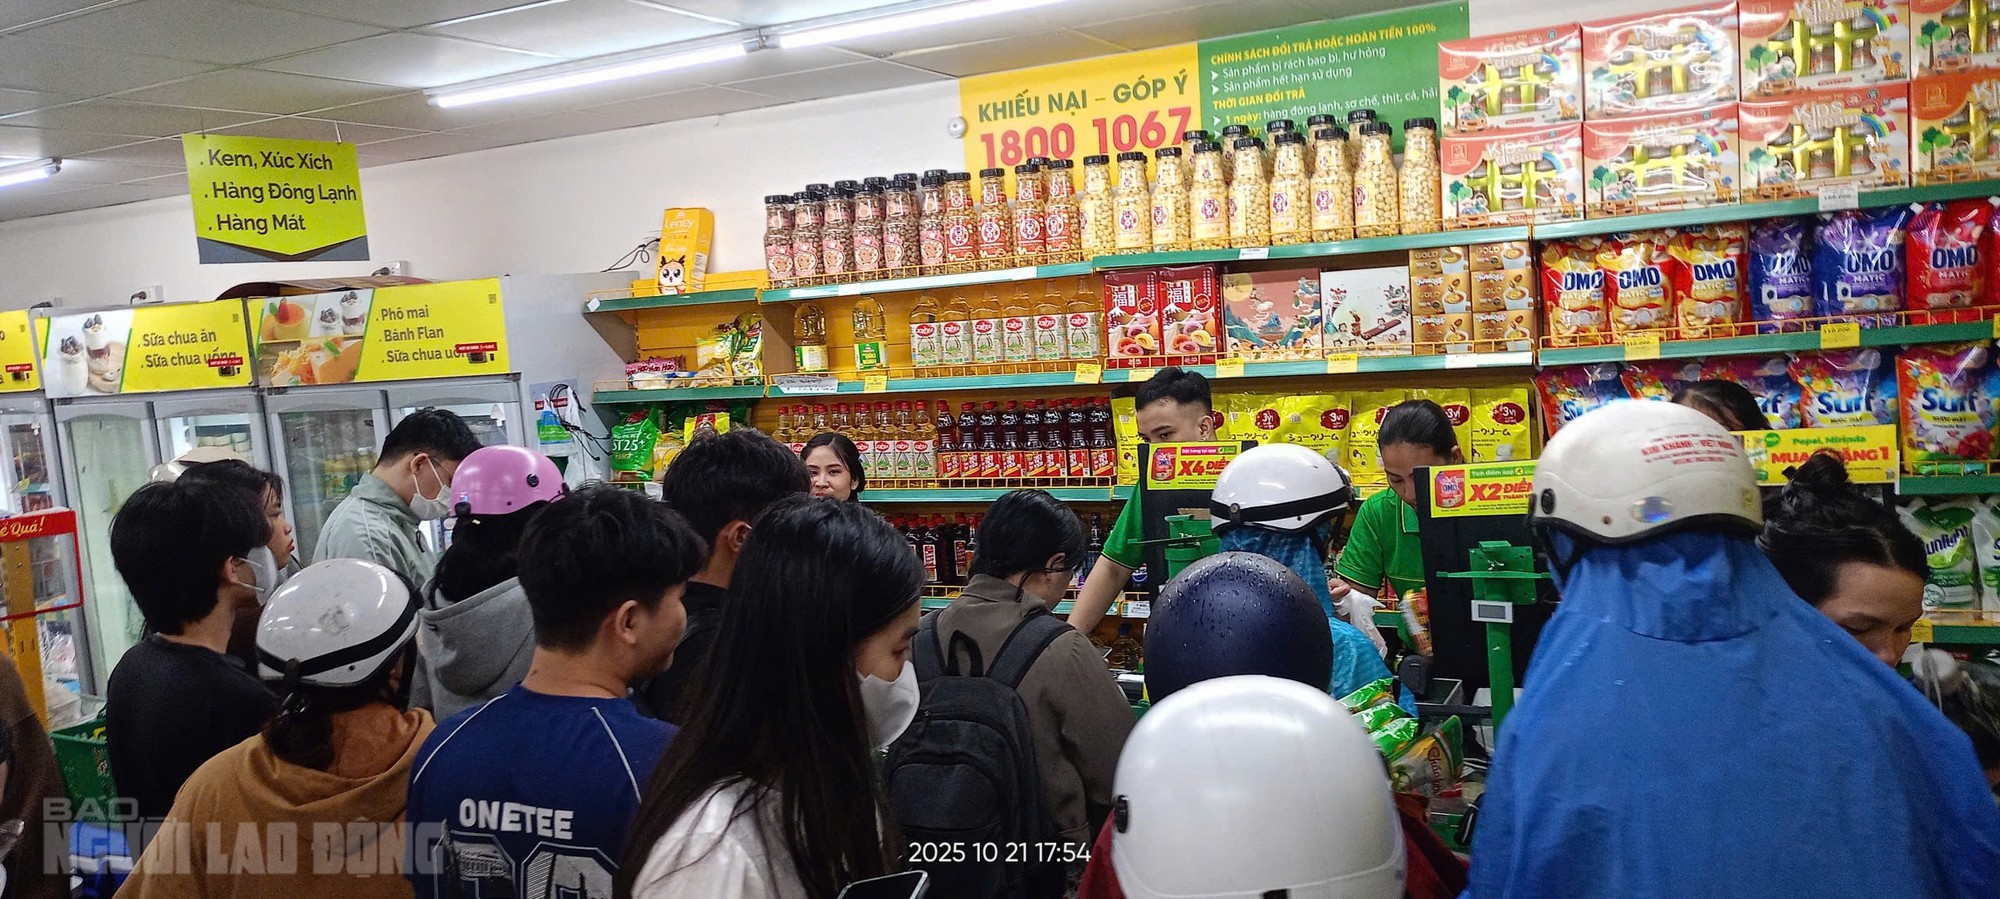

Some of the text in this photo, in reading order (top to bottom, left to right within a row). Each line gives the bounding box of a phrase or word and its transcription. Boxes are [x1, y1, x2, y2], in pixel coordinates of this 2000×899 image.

[1211, 52, 1241, 65] CHÍNH
[1244, 47, 1270, 60] SÁCH
[1272, 42, 1291, 56] ĐỔI
[1292, 38, 1312, 53] TRẢ
[1315, 35, 1343, 50] HOẶC
[1346, 30, 1377, 45] HOÀN
[1406, 23, 1436, 36] 100%
[1223, 67, 1240, 78] Sản
[1242, 62, 1270, 77] phẩm
[1272, 61, 1282, 72] bị
[1284, 57, 1305, 67] rách
[1307, 55, 1326, 67] bao
[1343, 49, 1358, 62] hư
[1359, 46, 1386, 59] hỏng
[1223, 66, 1352, 93] Sản phẩm hết hạn sử dụng
[978, 89, 1040, 123] KHIẾU
[1049, 89, 1087, 116] NẠI
[1113, 74, 1166, 104] GÓP
[1173, 69, 1188, 95] Ý
[1213, 86, 1306, 111] THỜI GIAN ĐỔI TRẢ
[1233, 112, 1261, 125] ngày:
[1263, 108, 1289, 120] hàng
[1345, 99, 1357, 109] sơ
[981, 106, 1191, 169] 1800 1067
[209, 149, 333, 170] Kem, Xúc Xích
[213, 181, 357, 204] Hàng Đông Lạnh
[216, 213, 306, 235] Hàng Mát
[1772, 253, 1811, 275] OMO
[1846, 249, 1895, 273] OMO
[1932, 245, 1978, 269] OMO
[1564, 271, 1603, 290] OMO
[1619, 267, 1660, 289] OMO
[1693, 259, 1736, 281] OMO
[1852, 273, 1885, 283] MATIC
[407, 305, 429, 319] mai
[143, 329, 217, 347] Sữa chua ăn
[384, 326, 444, 342] Bánh Flan
[145, 354, 168, 368] Sữa
[171, 352, 201, 366] chua
[387, 349, 409, 362] Sữa
[412, 348, 442, 361] chua
[1818, 388, 1875, 414] Surf
[1922, 387, 1978, 413] Surf
[1177, 456, 1230, 476] X4 ĐIỂ
[1772, 446, 1889, 465] MUA ẶNG 1
[1468, 483, 1503, 502] X2
[10, 516, 45, 537] Quá!
[1926, 525, 1969, 555] unlight
[458, 798, 575, 840] ONETEE
